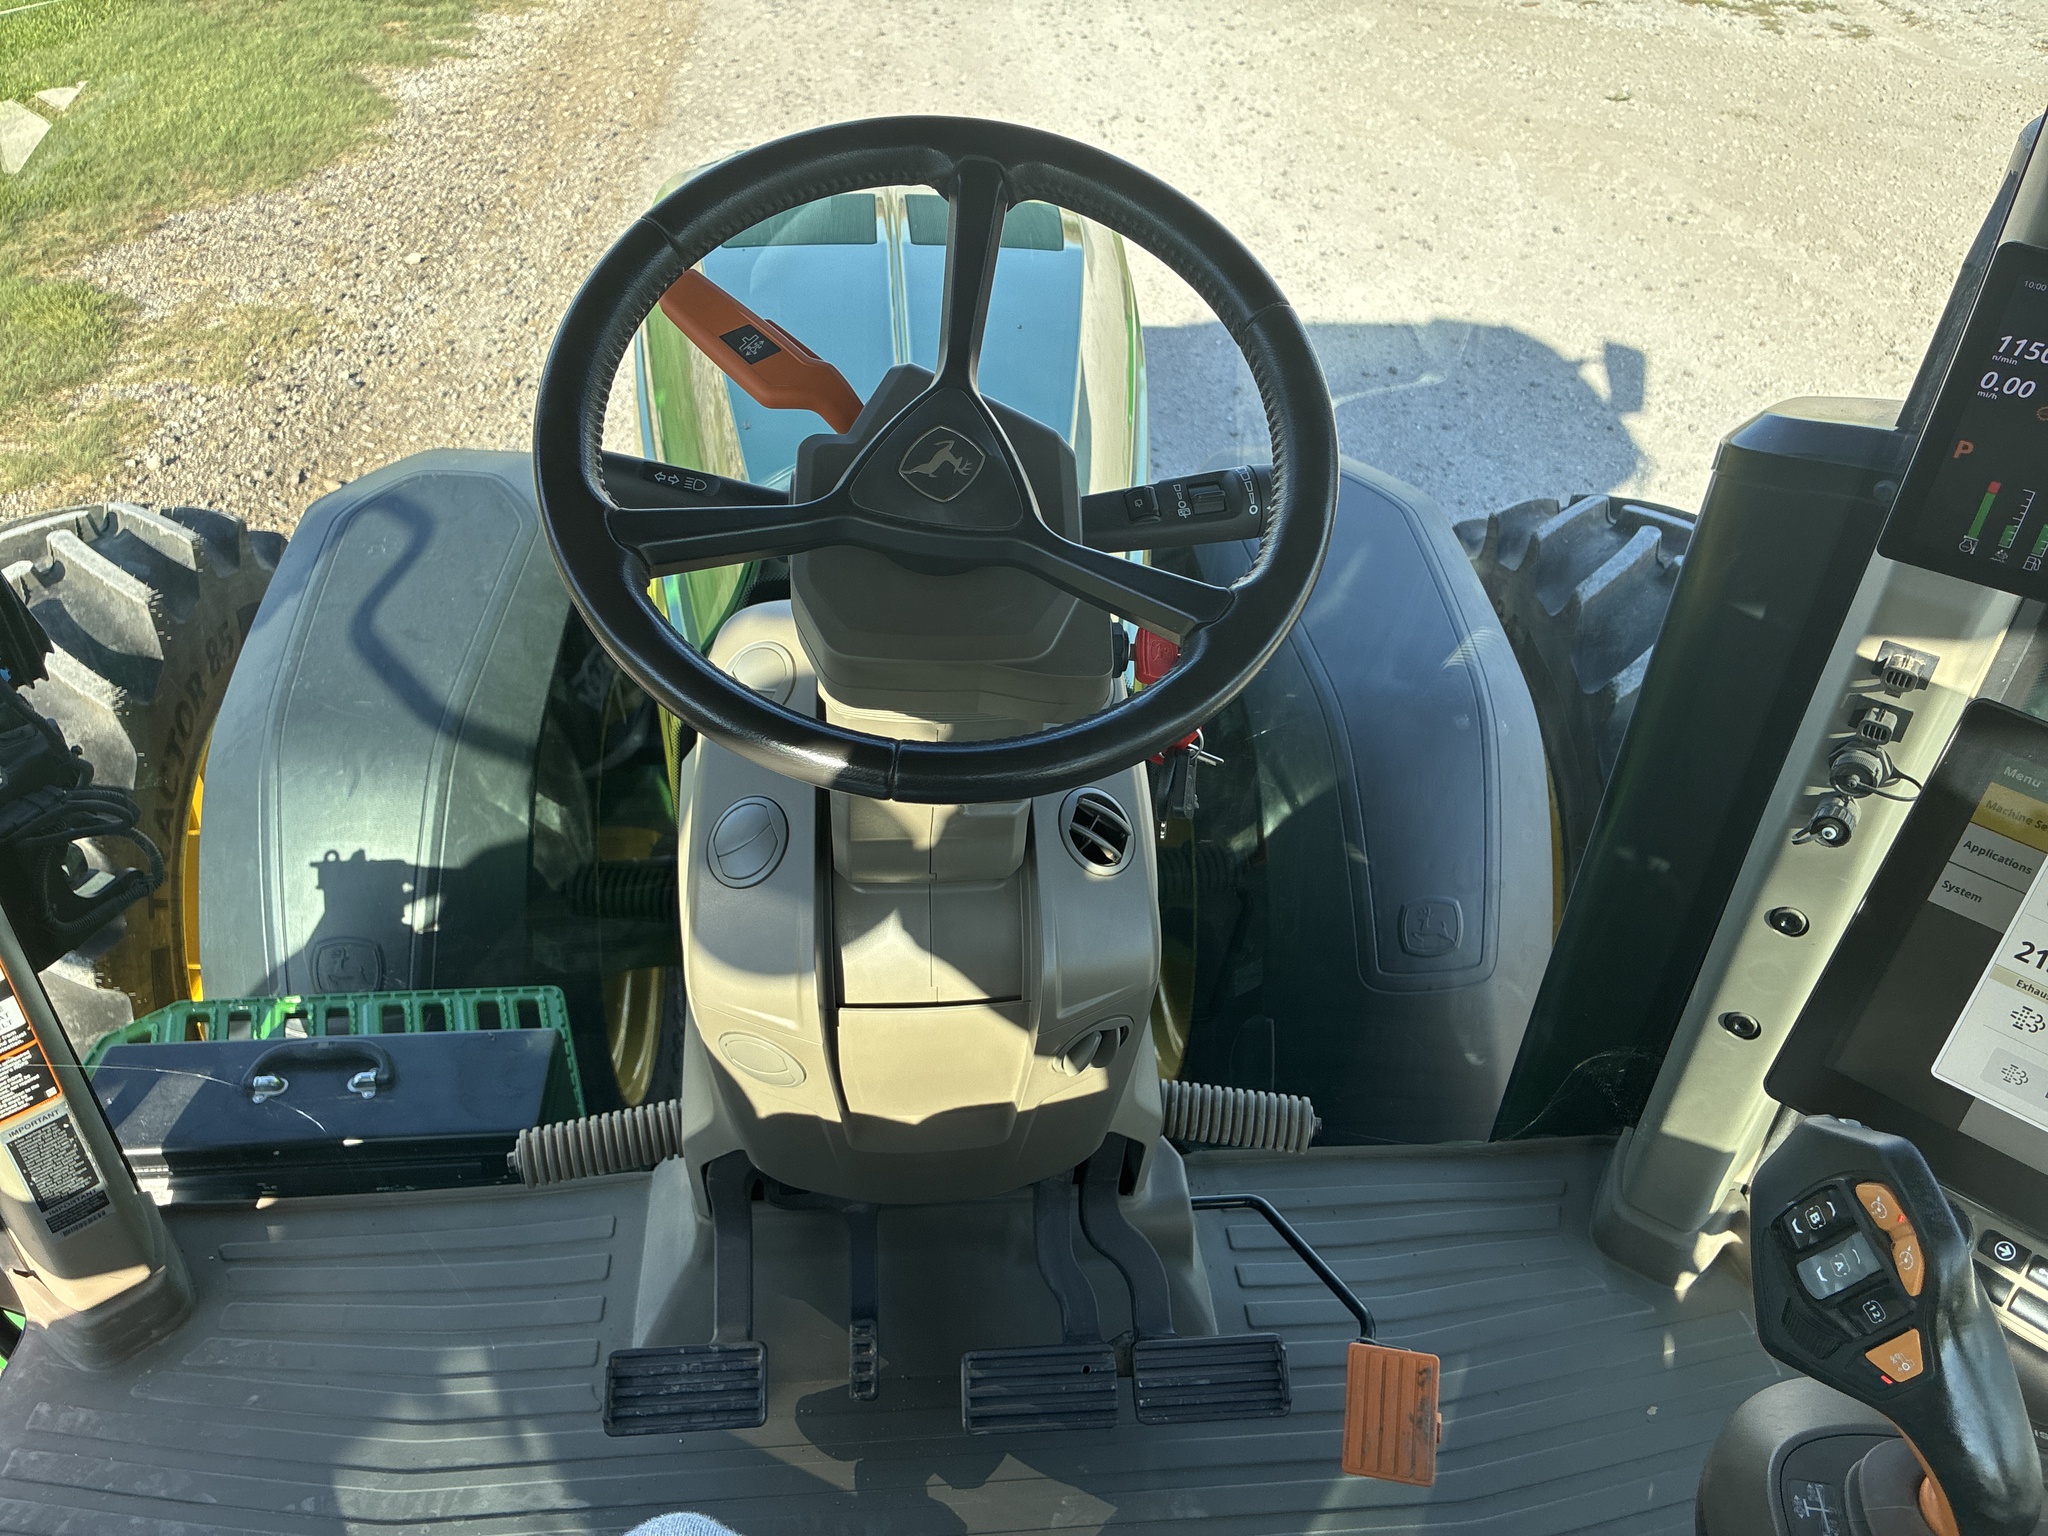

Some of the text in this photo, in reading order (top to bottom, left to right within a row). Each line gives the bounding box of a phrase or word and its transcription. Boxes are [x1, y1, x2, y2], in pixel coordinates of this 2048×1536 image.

[2024, 280, 2047, 292] 10:00
[1992, 355, 2018, 366] n/min
[1977, 390, 1998, 400] mi/h
[1980, 371, 2036, 399] 0.00
[1953, 439, 1974, 459] P
[2003, 766, 2042, 788] Menu
[1985, 800, 2033, 825] Machine
[1963, 840, 2033, 875] Applications
[1942, 880, 1983, 903] System
[8, 1109, 60, 1138] IMPORTANT
[1809, 1212, 1821, 1225] B
[1834, 1261, 1844, 1272] A
